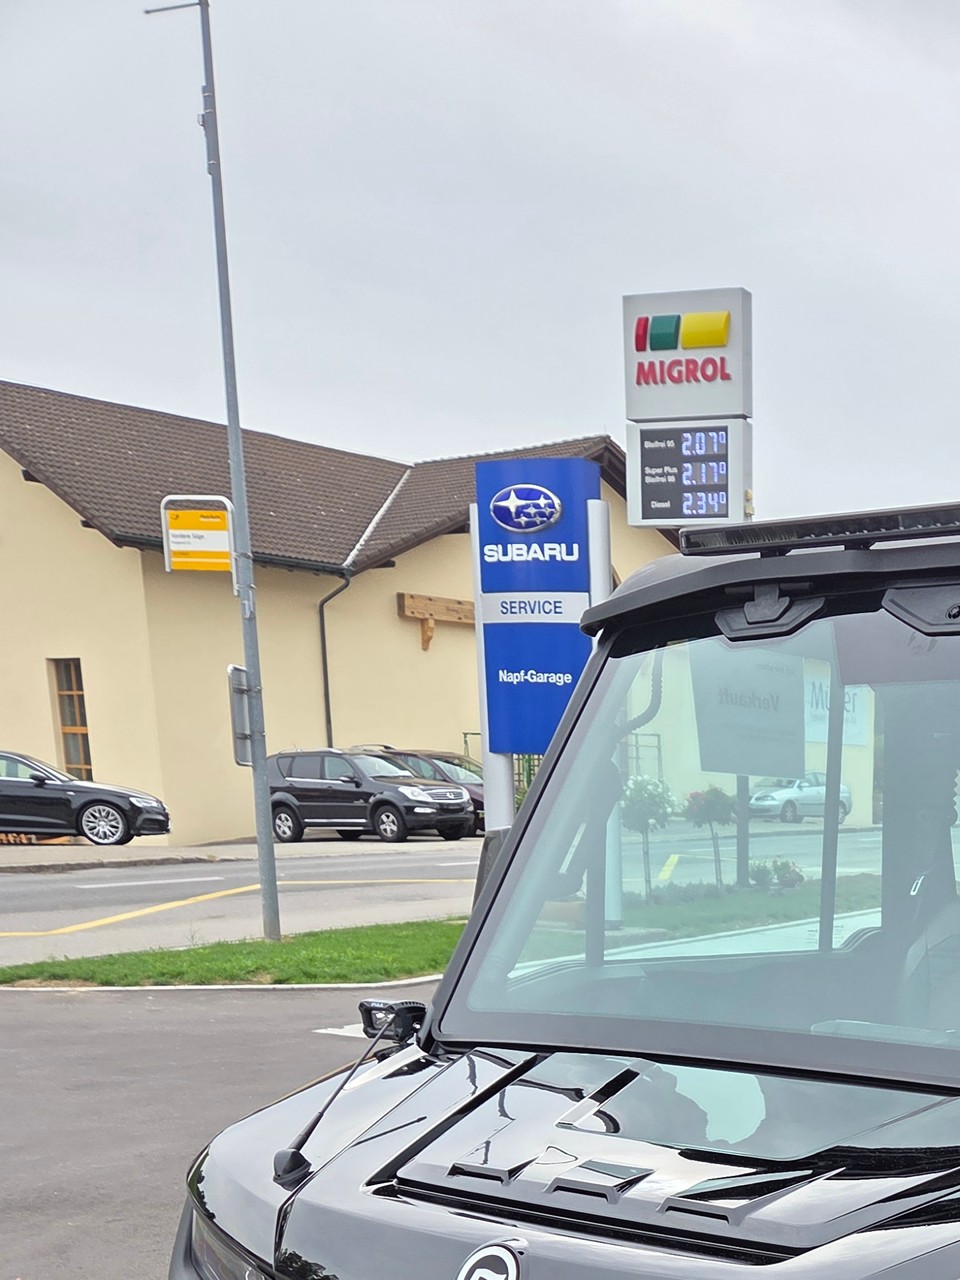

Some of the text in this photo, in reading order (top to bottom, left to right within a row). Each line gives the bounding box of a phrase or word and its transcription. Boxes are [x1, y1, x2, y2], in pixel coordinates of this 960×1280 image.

[635, 355, 732, 386] MIGROL
[483, 543, 579, 563] SUBARU
[500, 600, 563, 615] SERVICE
[498, 669, 573, 687] Napf-Garage
